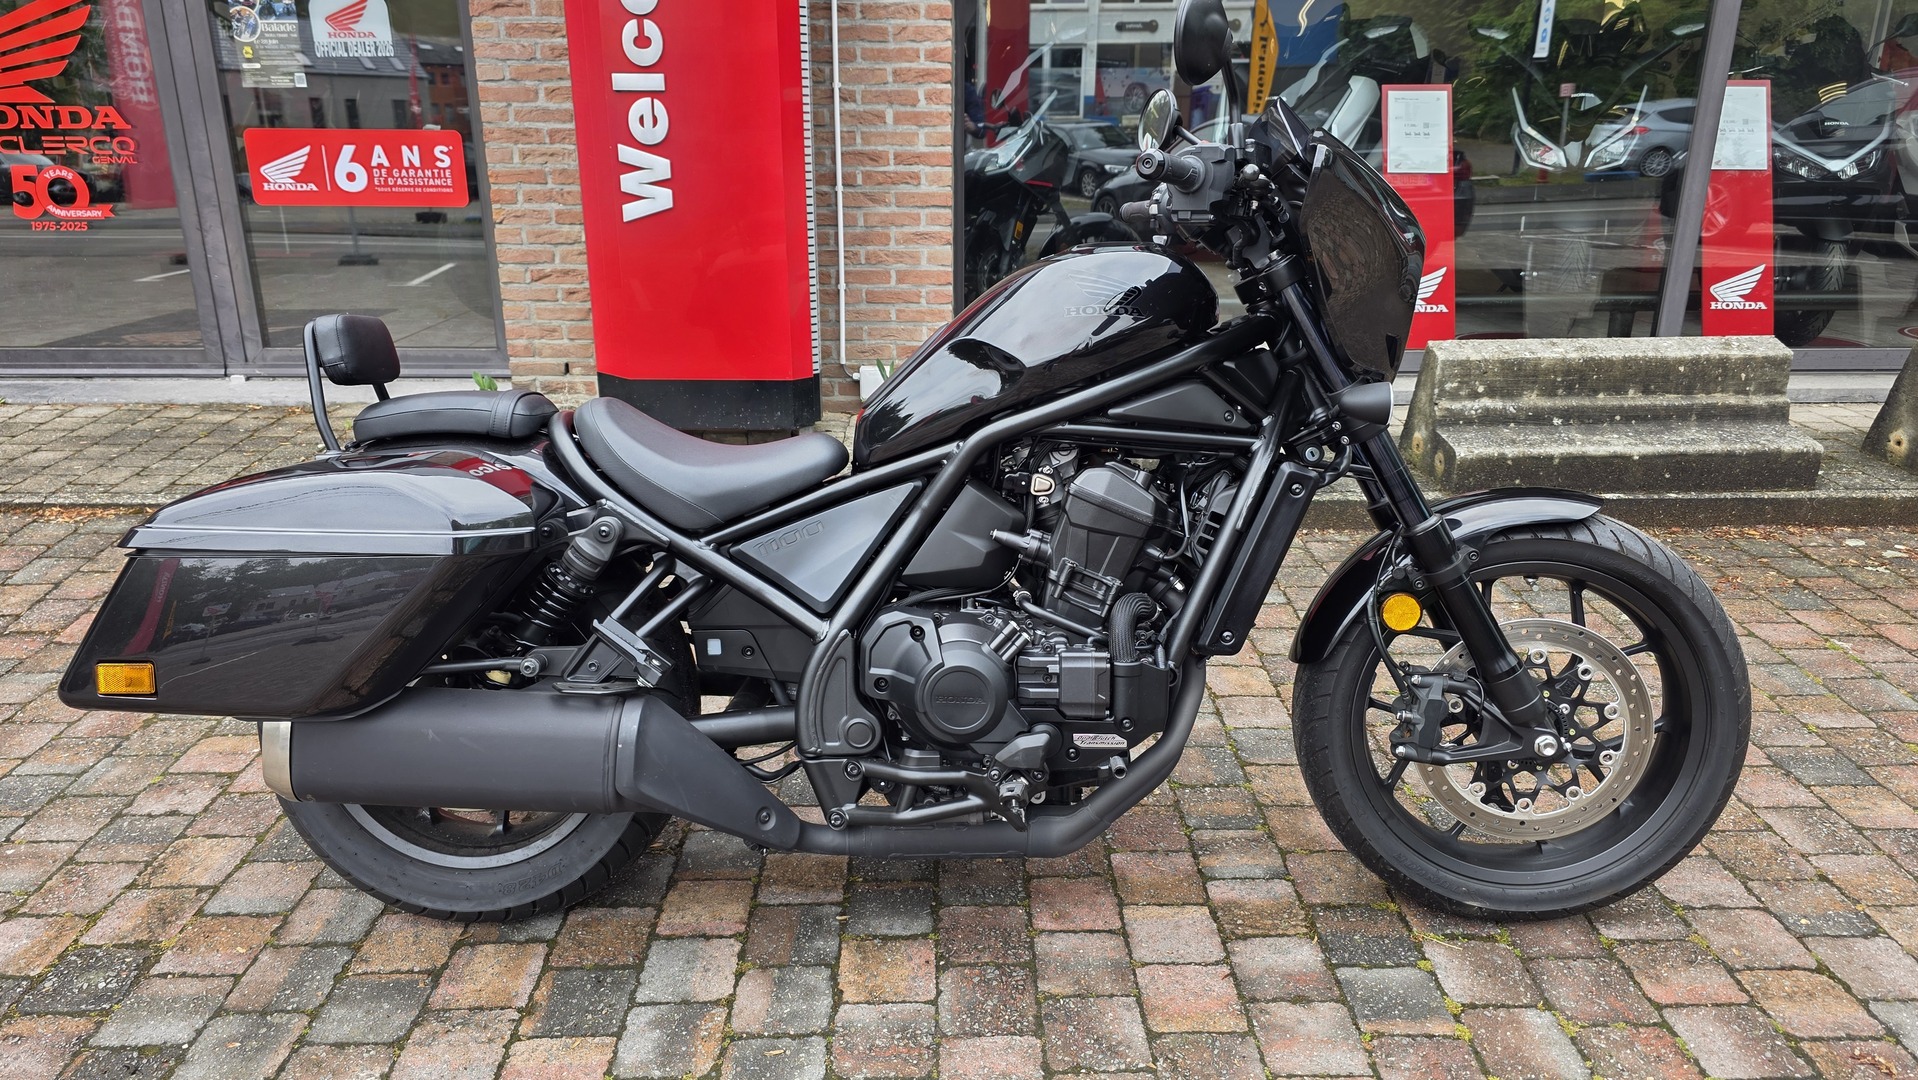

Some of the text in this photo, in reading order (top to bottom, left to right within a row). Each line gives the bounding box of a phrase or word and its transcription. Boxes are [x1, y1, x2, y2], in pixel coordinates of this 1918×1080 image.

[261, 23, 296, 32] Balade
[327, 31, 377, 39] HONDA
[314, 41, 348, 58] OFFICIAL
[347, 41, 377, 57] DEALER
[611, 0, 673, 223] Welc
[92, 156, 138, 164] GENVAL
[334, 144, 368, 193] 6
[372, 168, 452, 178] DE GARANTIE
[43, 169, 74, 180] YEARS
[263, 182, 319, 191] HONDA
[374, 177, 453, 187] ET D'ASSISTANCE
[10, 164, 90, 220] 50
[46, 204, 103, 218] ANNIVERSARY
[31, 221, 88, 231] 1975-2025
[1710, 301, 1768, 310] HONDA
[1063, 305, 1146, 319] HONDA
[752, 520, 825, 558] 1100
[935, 696, 987, 705] HONDA
